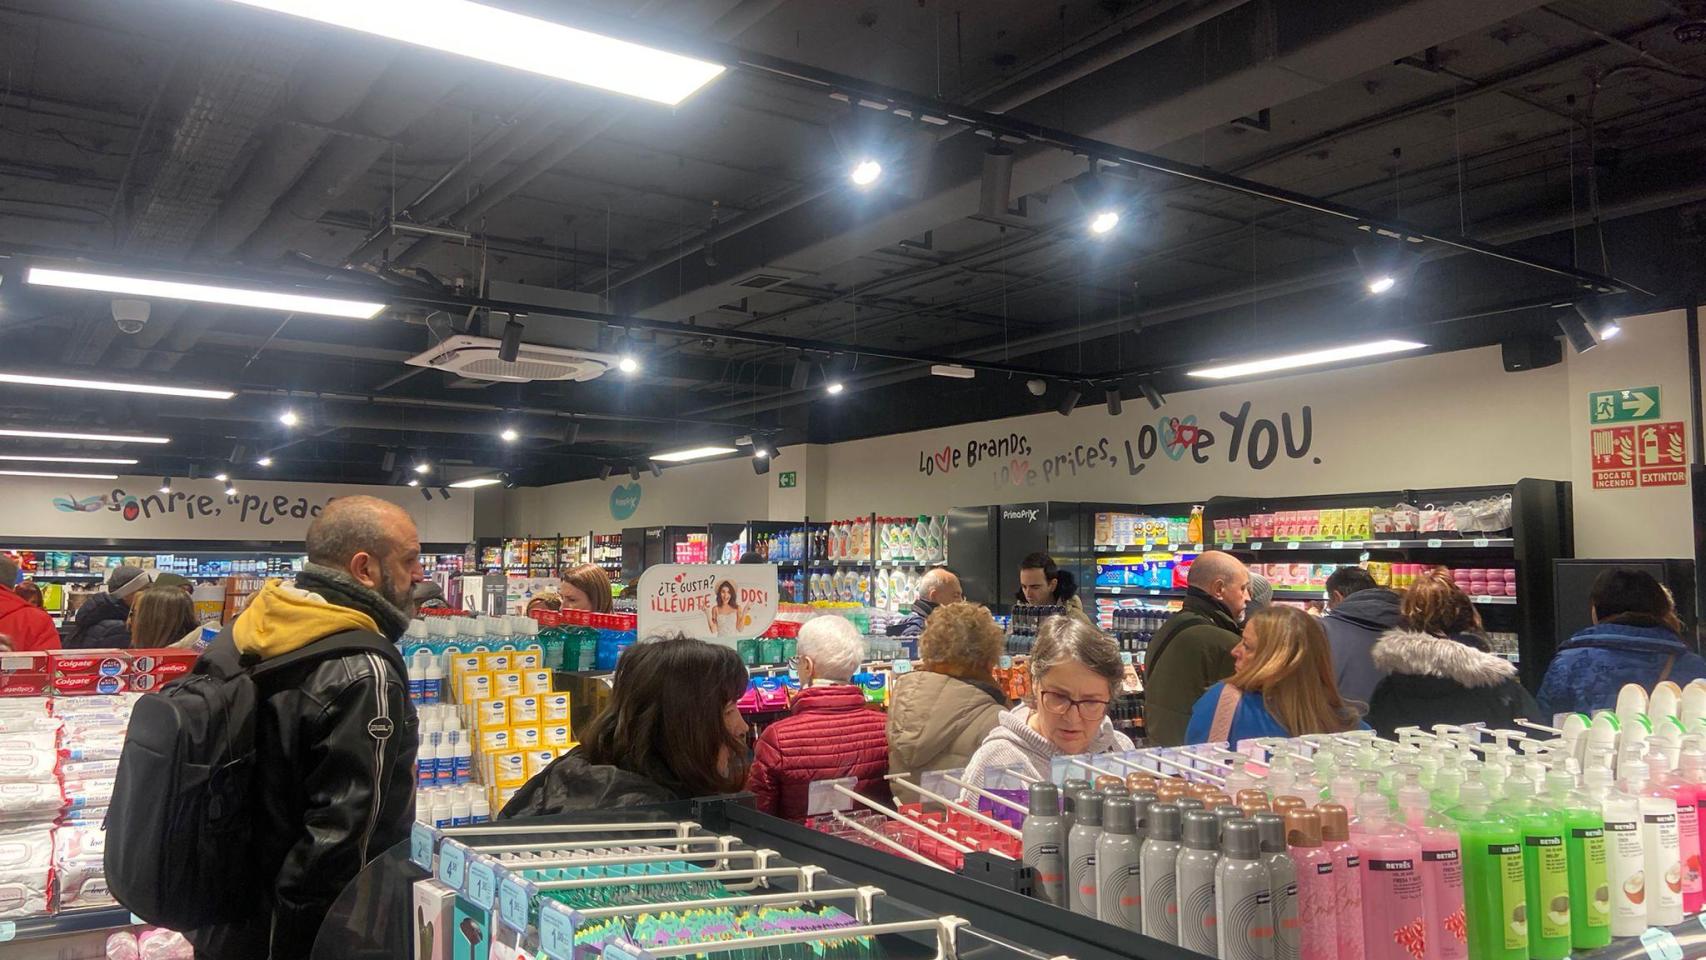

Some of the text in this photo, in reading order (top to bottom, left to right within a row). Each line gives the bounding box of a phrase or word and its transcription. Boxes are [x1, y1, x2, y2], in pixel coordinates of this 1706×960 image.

[1042, 437, 1118, 484] prices,
[1219, 401, 1322, 470] YOU.
[1598, 471, 1632, 480] BOCA DE
[1642, 472, 1685, 482] EXTINTOR
[1596, 479, 1635, 488] INCENDIO
[658, 574, 716, 596] ¿TE GUSTA?
[651, 588, 768, 613] ¡LLÉVATE DOS!
[58, 660, 92, 668] Colgate
[55, 678, 90, 686] Colgate
